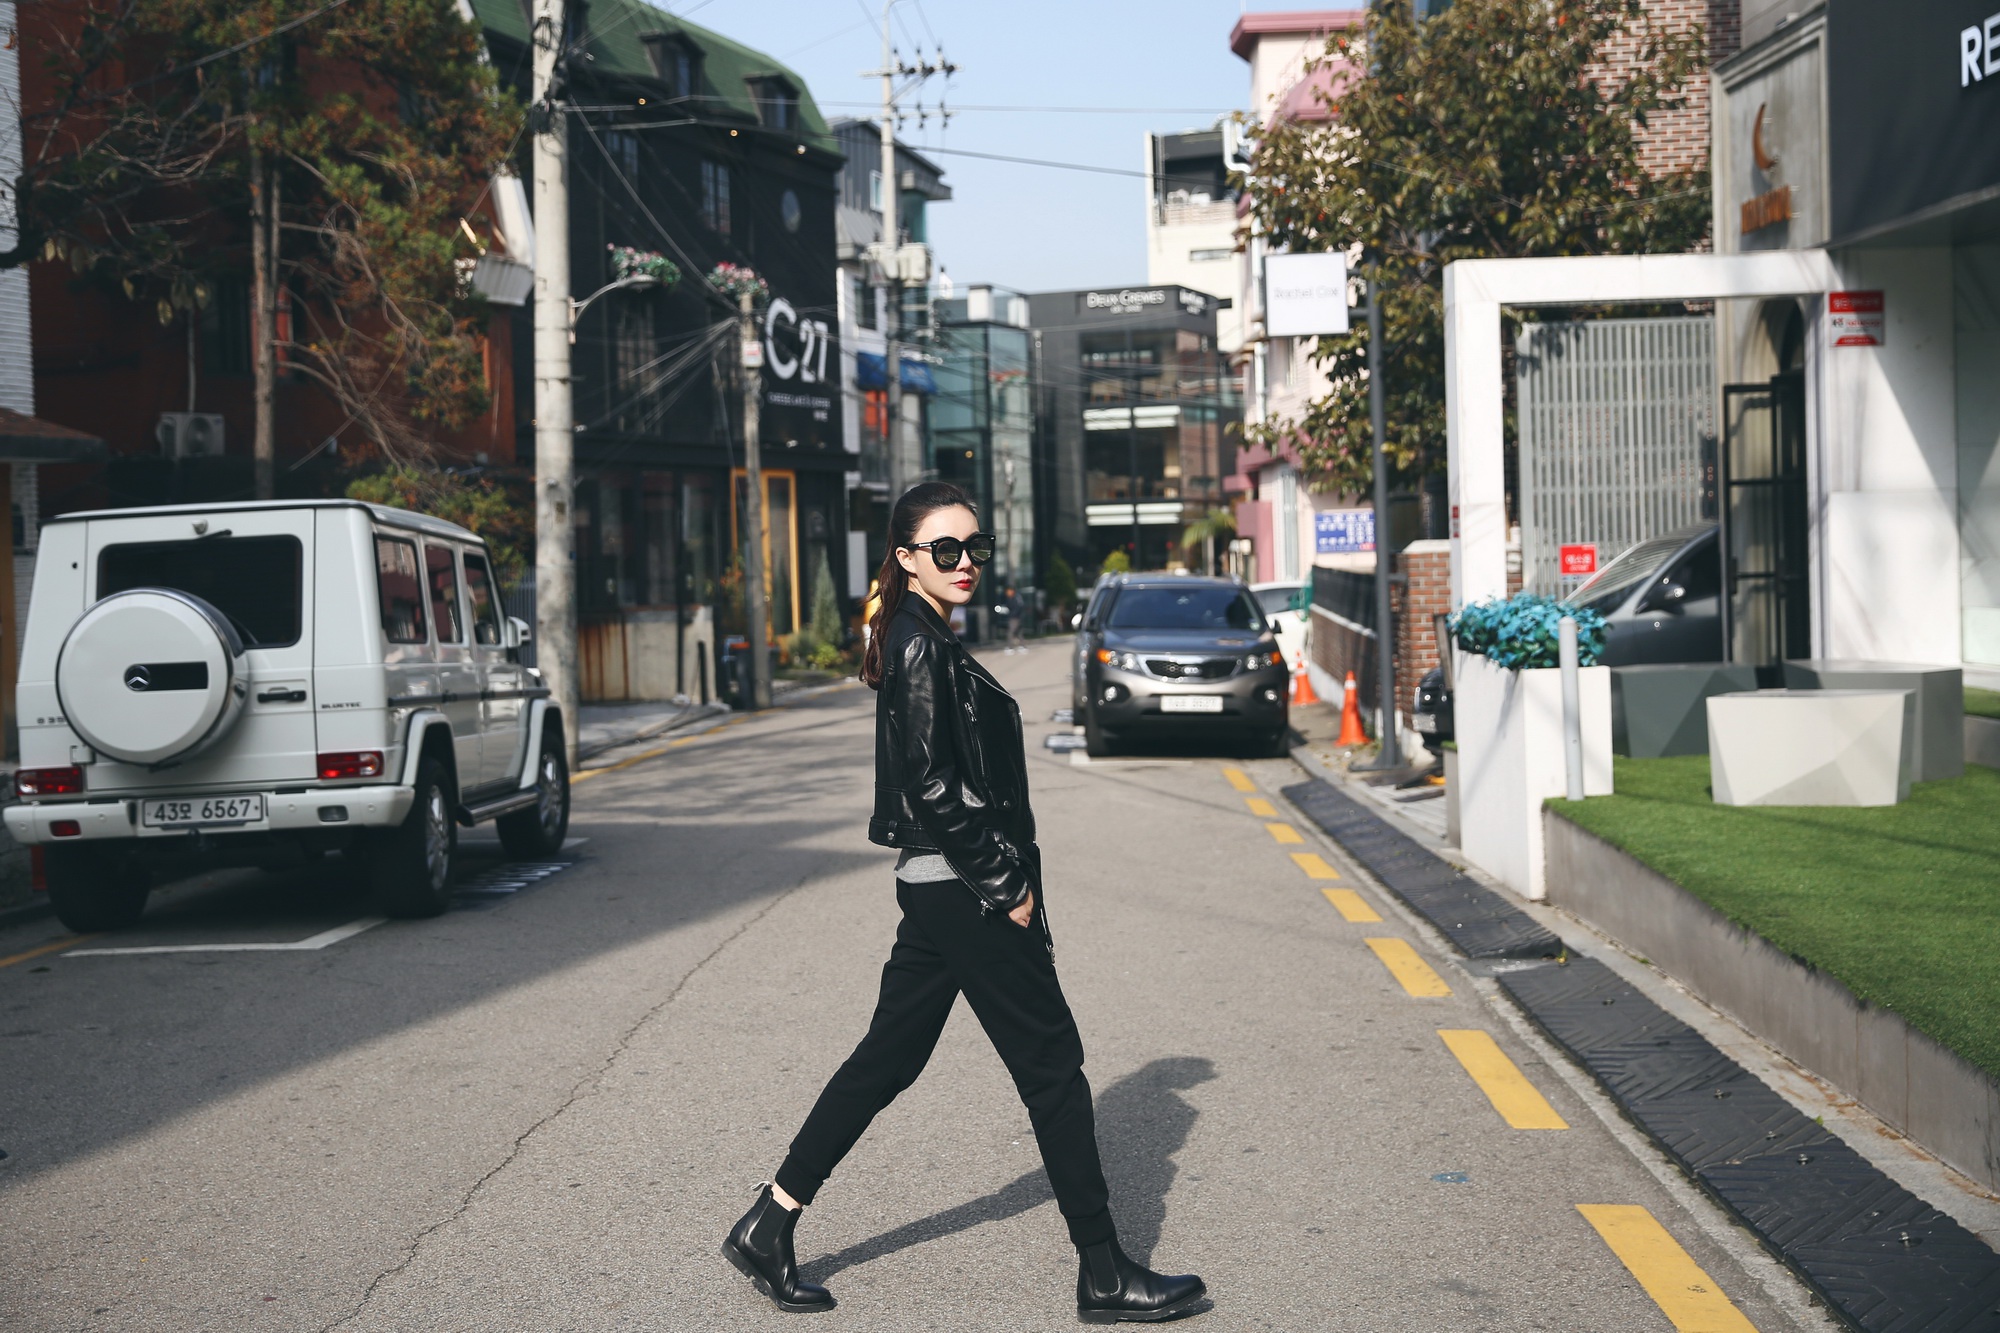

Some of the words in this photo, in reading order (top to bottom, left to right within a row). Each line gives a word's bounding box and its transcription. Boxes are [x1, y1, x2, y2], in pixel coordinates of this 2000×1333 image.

[1961, 12, 2000, 88] RE
[765, 297, 828, 382] C27
[202, 799, 250, 819] 6567
